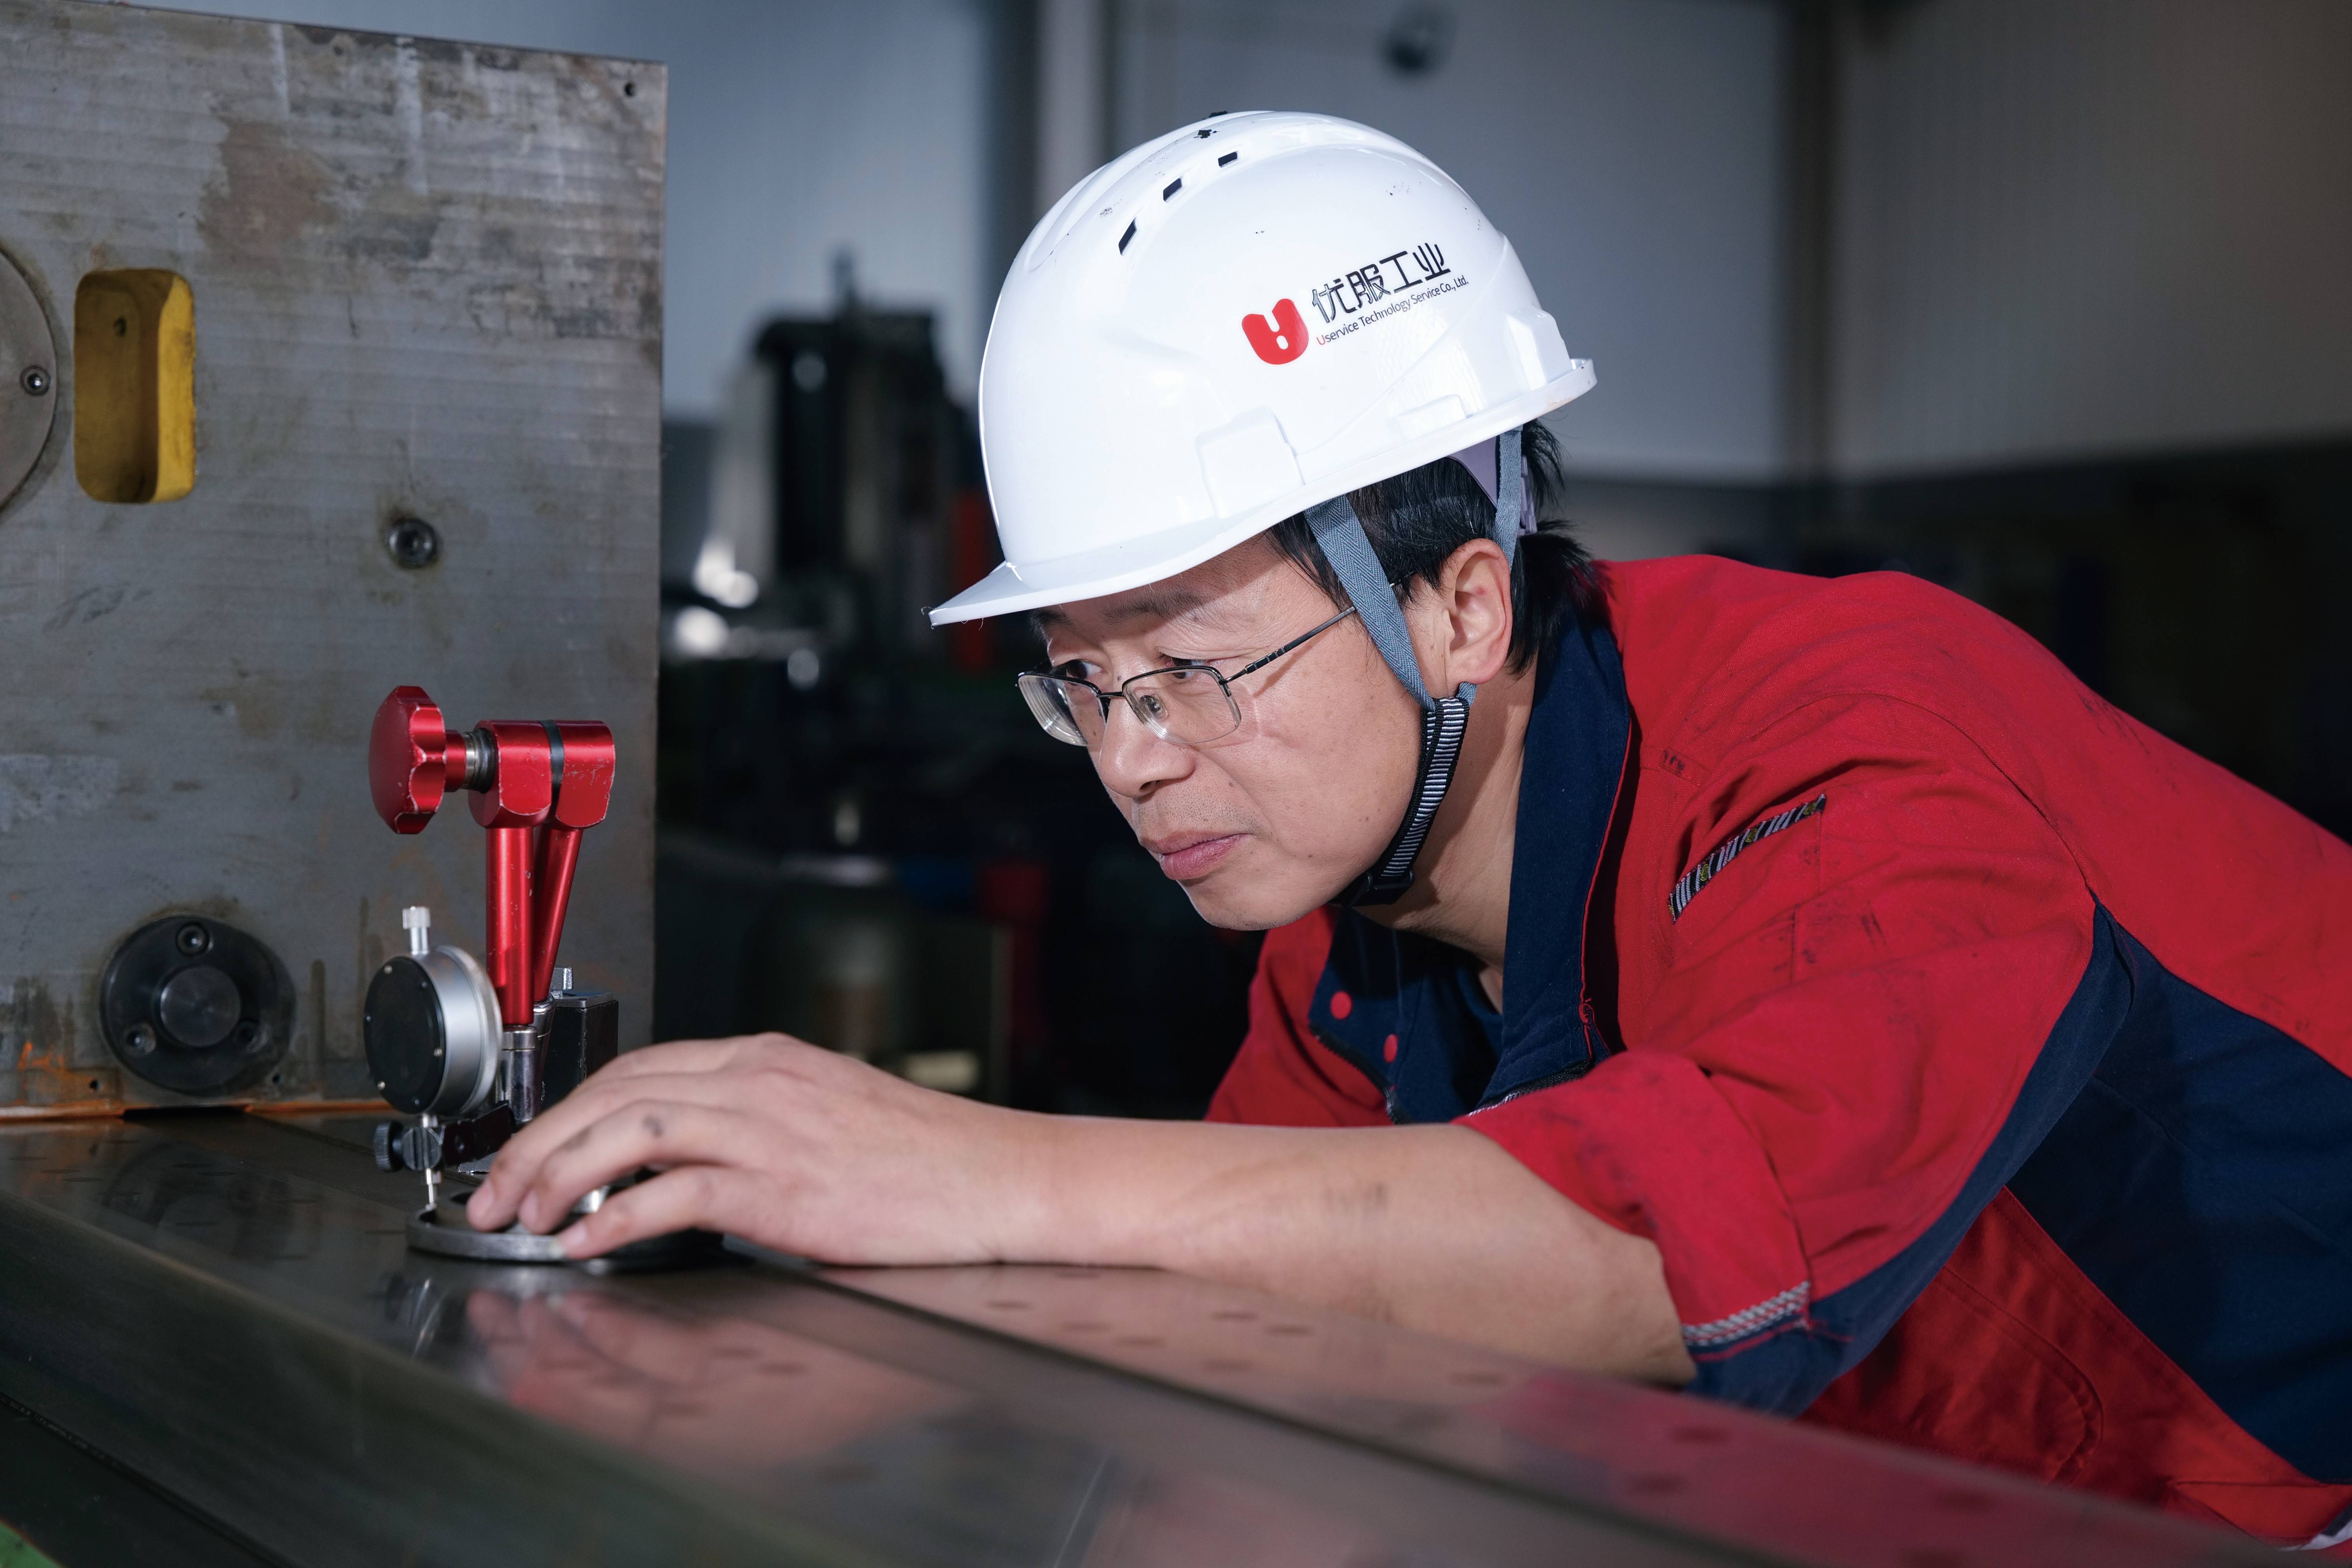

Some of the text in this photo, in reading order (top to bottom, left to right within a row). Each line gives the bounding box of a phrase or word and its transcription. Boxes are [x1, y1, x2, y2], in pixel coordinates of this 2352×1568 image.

[1312, 242, 1451, 323] 优服工业
[1316, 322, 1359, 345] Uservice
[1358, 299, 1411, 327] Technology
[1410, 288, 1441, 305] Service
